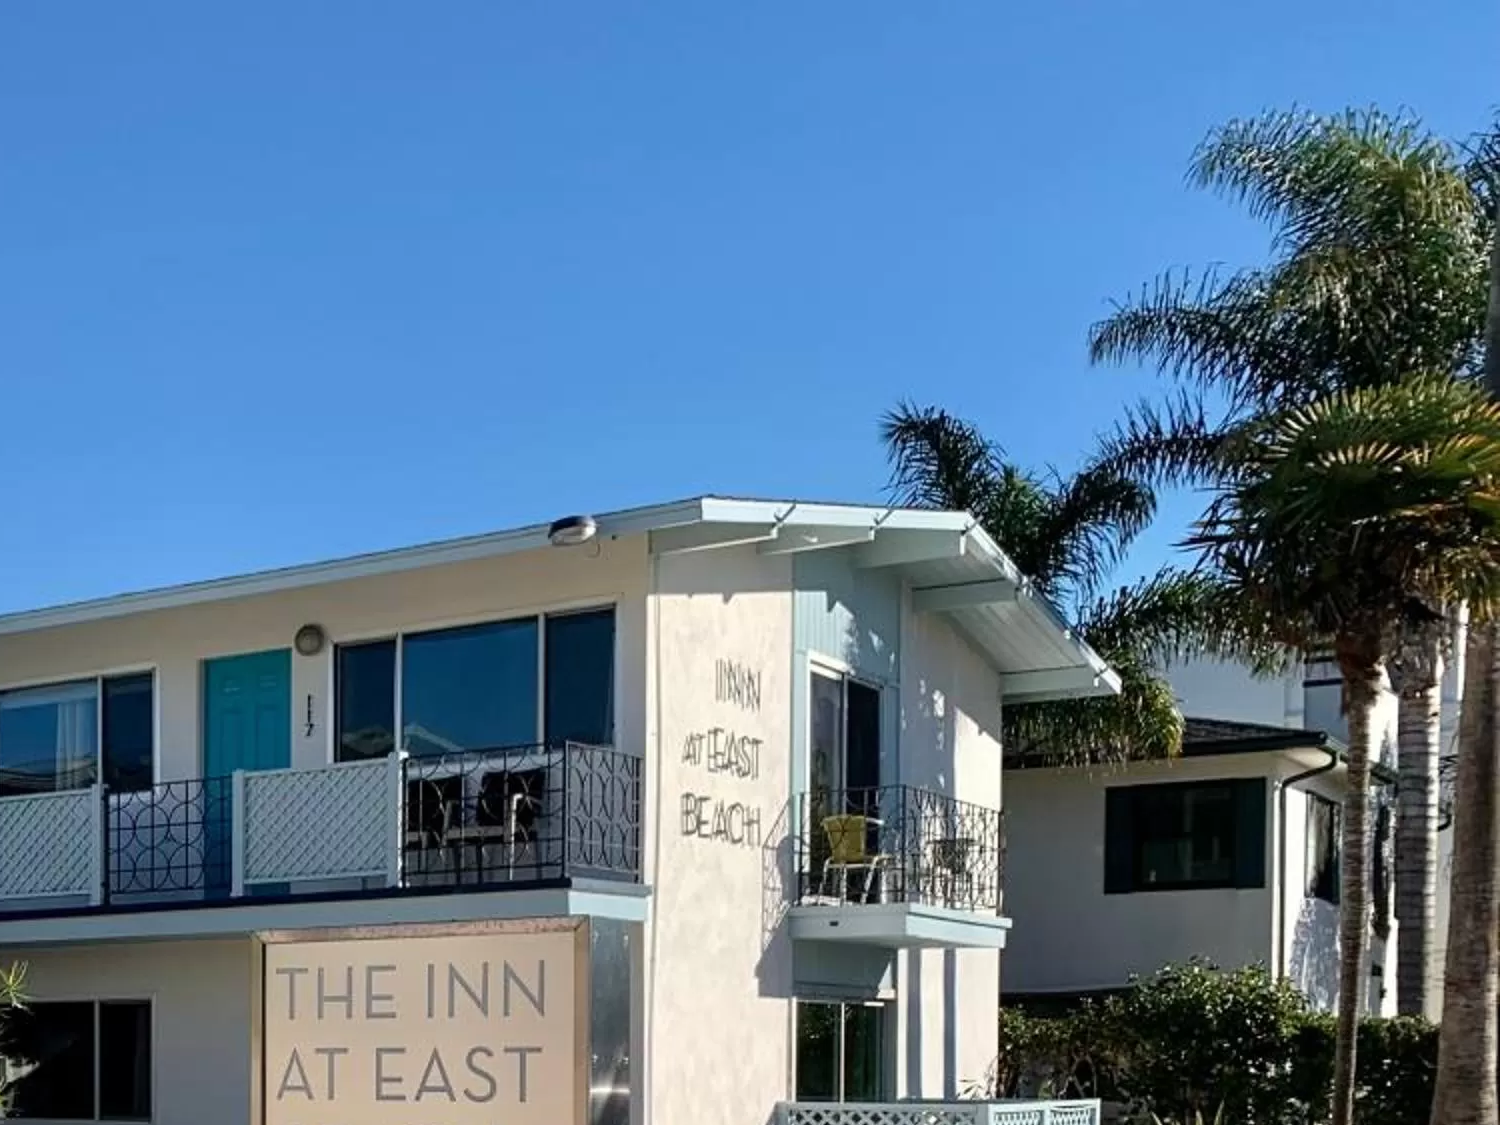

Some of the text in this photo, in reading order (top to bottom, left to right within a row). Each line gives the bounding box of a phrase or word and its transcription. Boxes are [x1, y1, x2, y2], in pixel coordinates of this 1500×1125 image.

[715, 658, 761, 712] INN
[682, 727, 763, 780] AT EAST
[681, 792, 761, 848] BEACH
[275, 959, 546, 1020] THE INN
[276, 1046, 543, 1103] AT EAST
